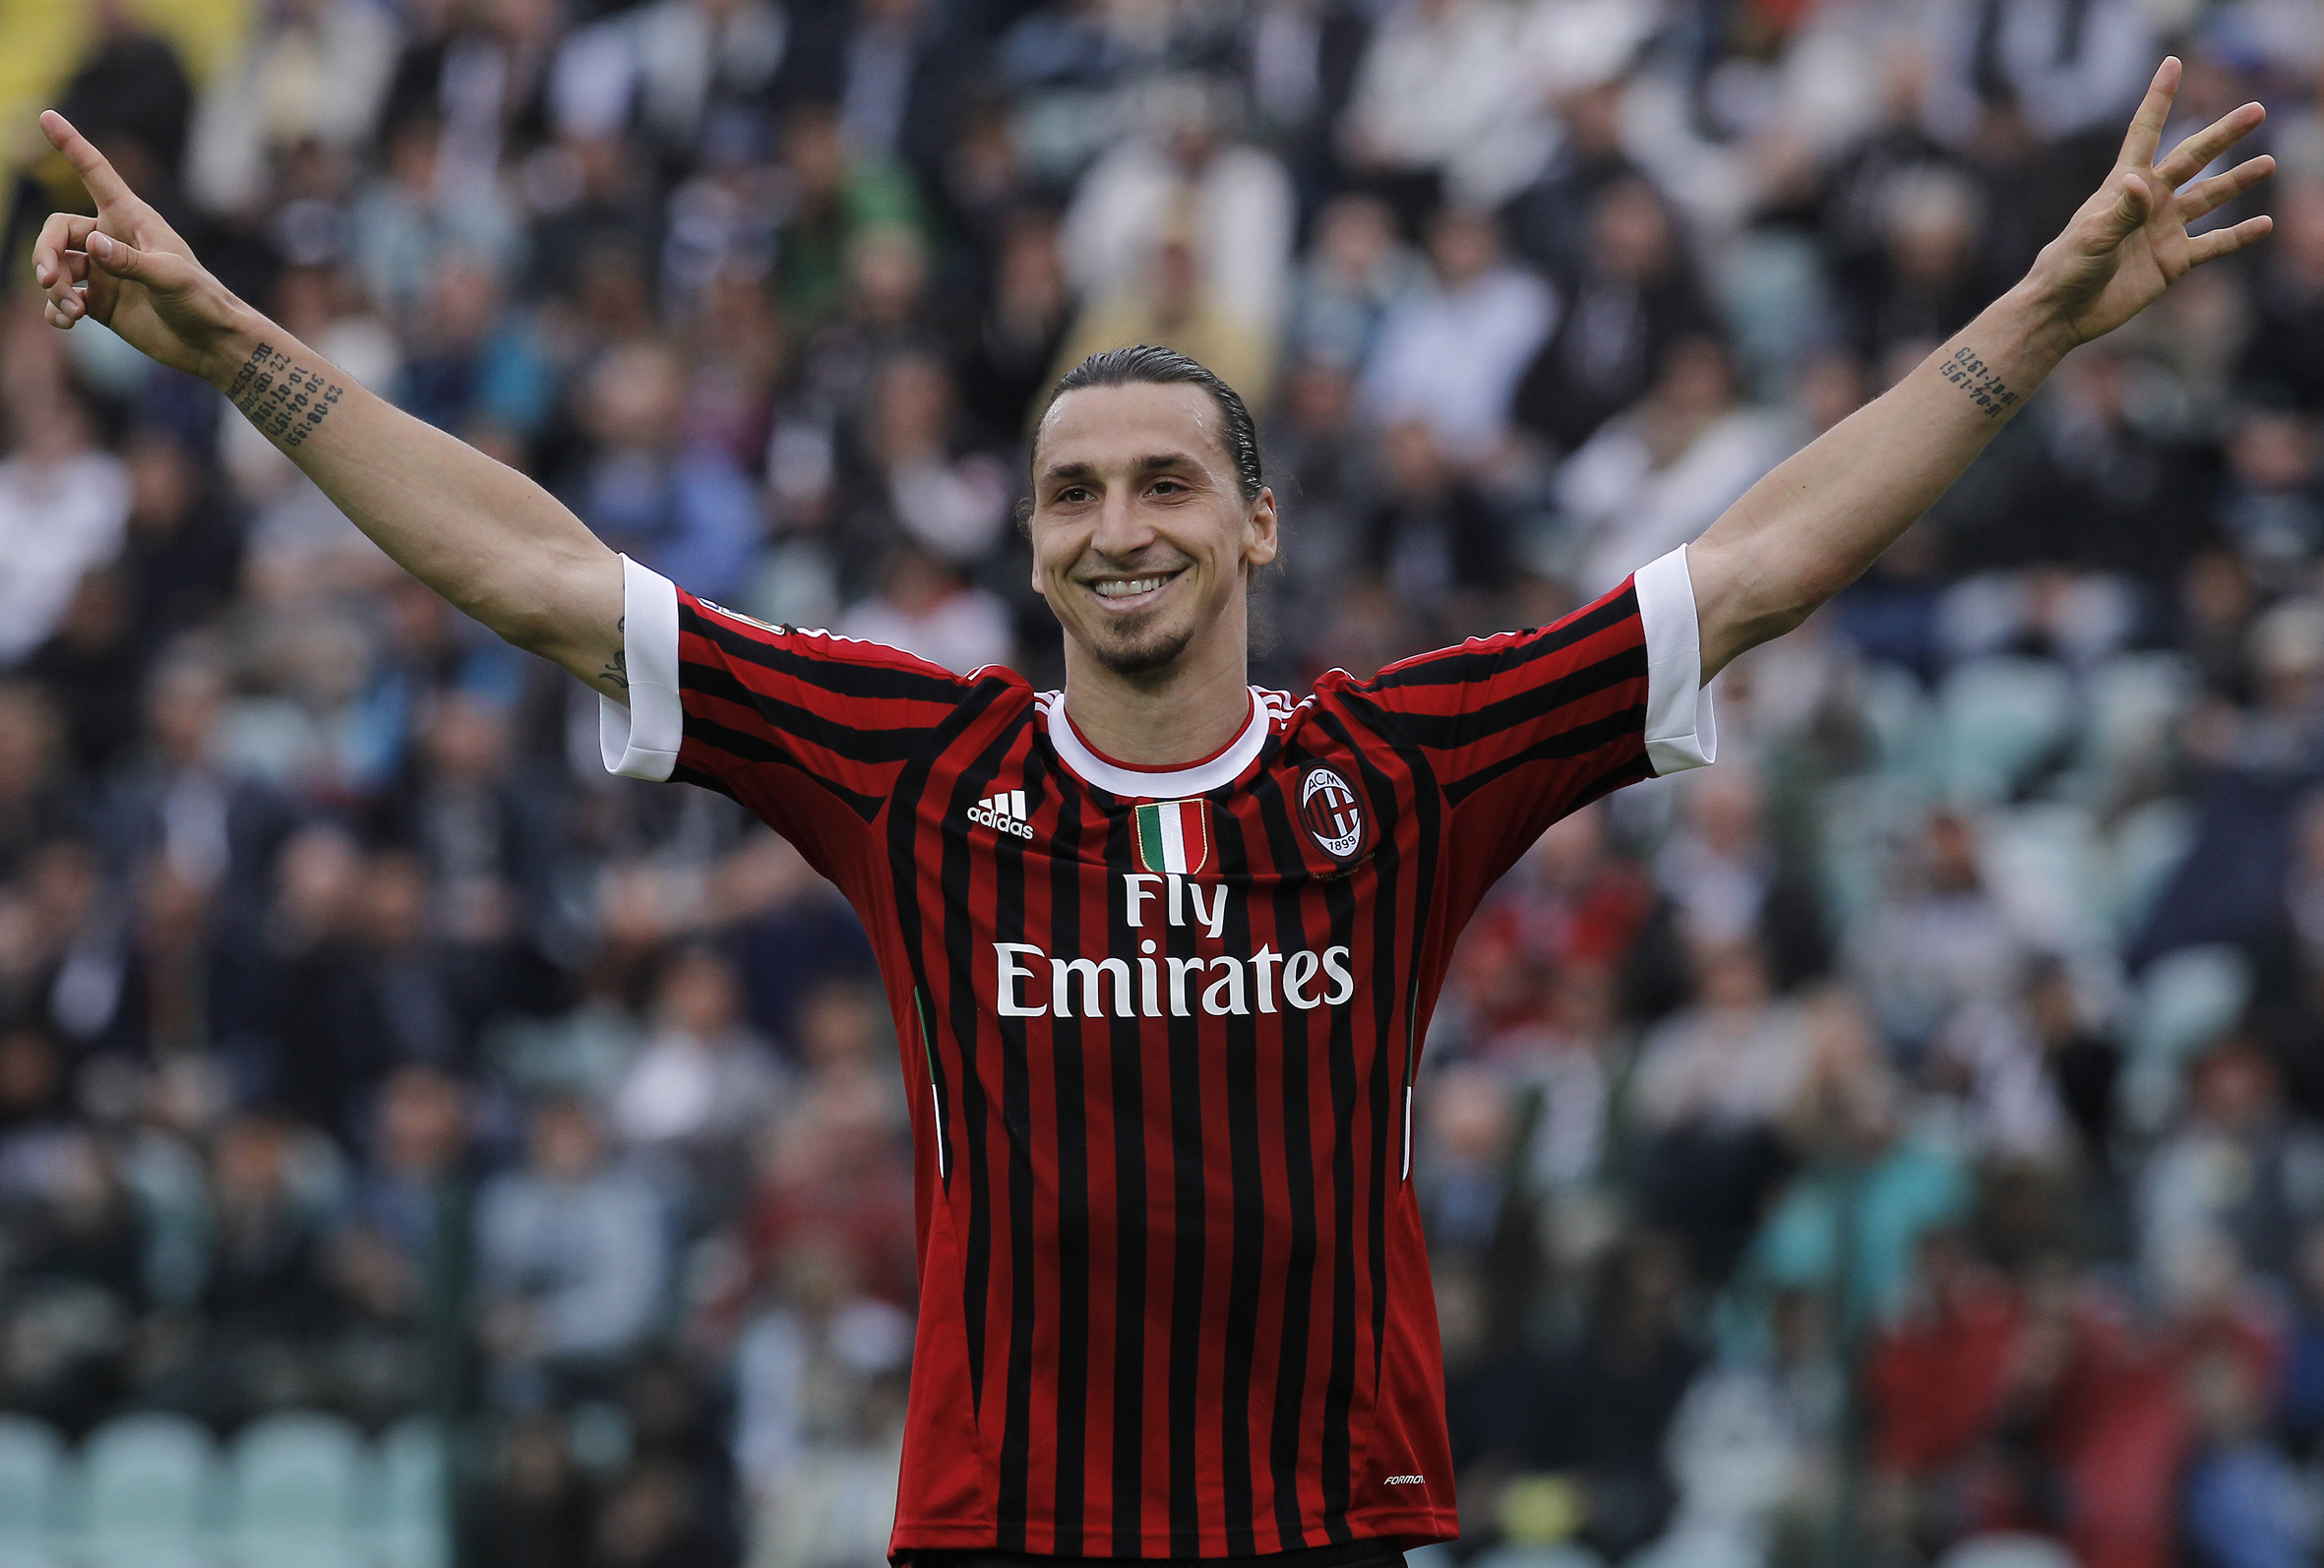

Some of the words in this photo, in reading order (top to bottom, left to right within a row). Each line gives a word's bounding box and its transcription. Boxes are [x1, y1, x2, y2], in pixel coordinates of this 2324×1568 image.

[1308, 772, 1340, 795] ACM
[967, 807, 1033, 839] adidas
[1328, 836, 1356, 850] 1899
[1122, 874, 1228, 937] Fly
[992, 939, 1354, 1017] Emirates
